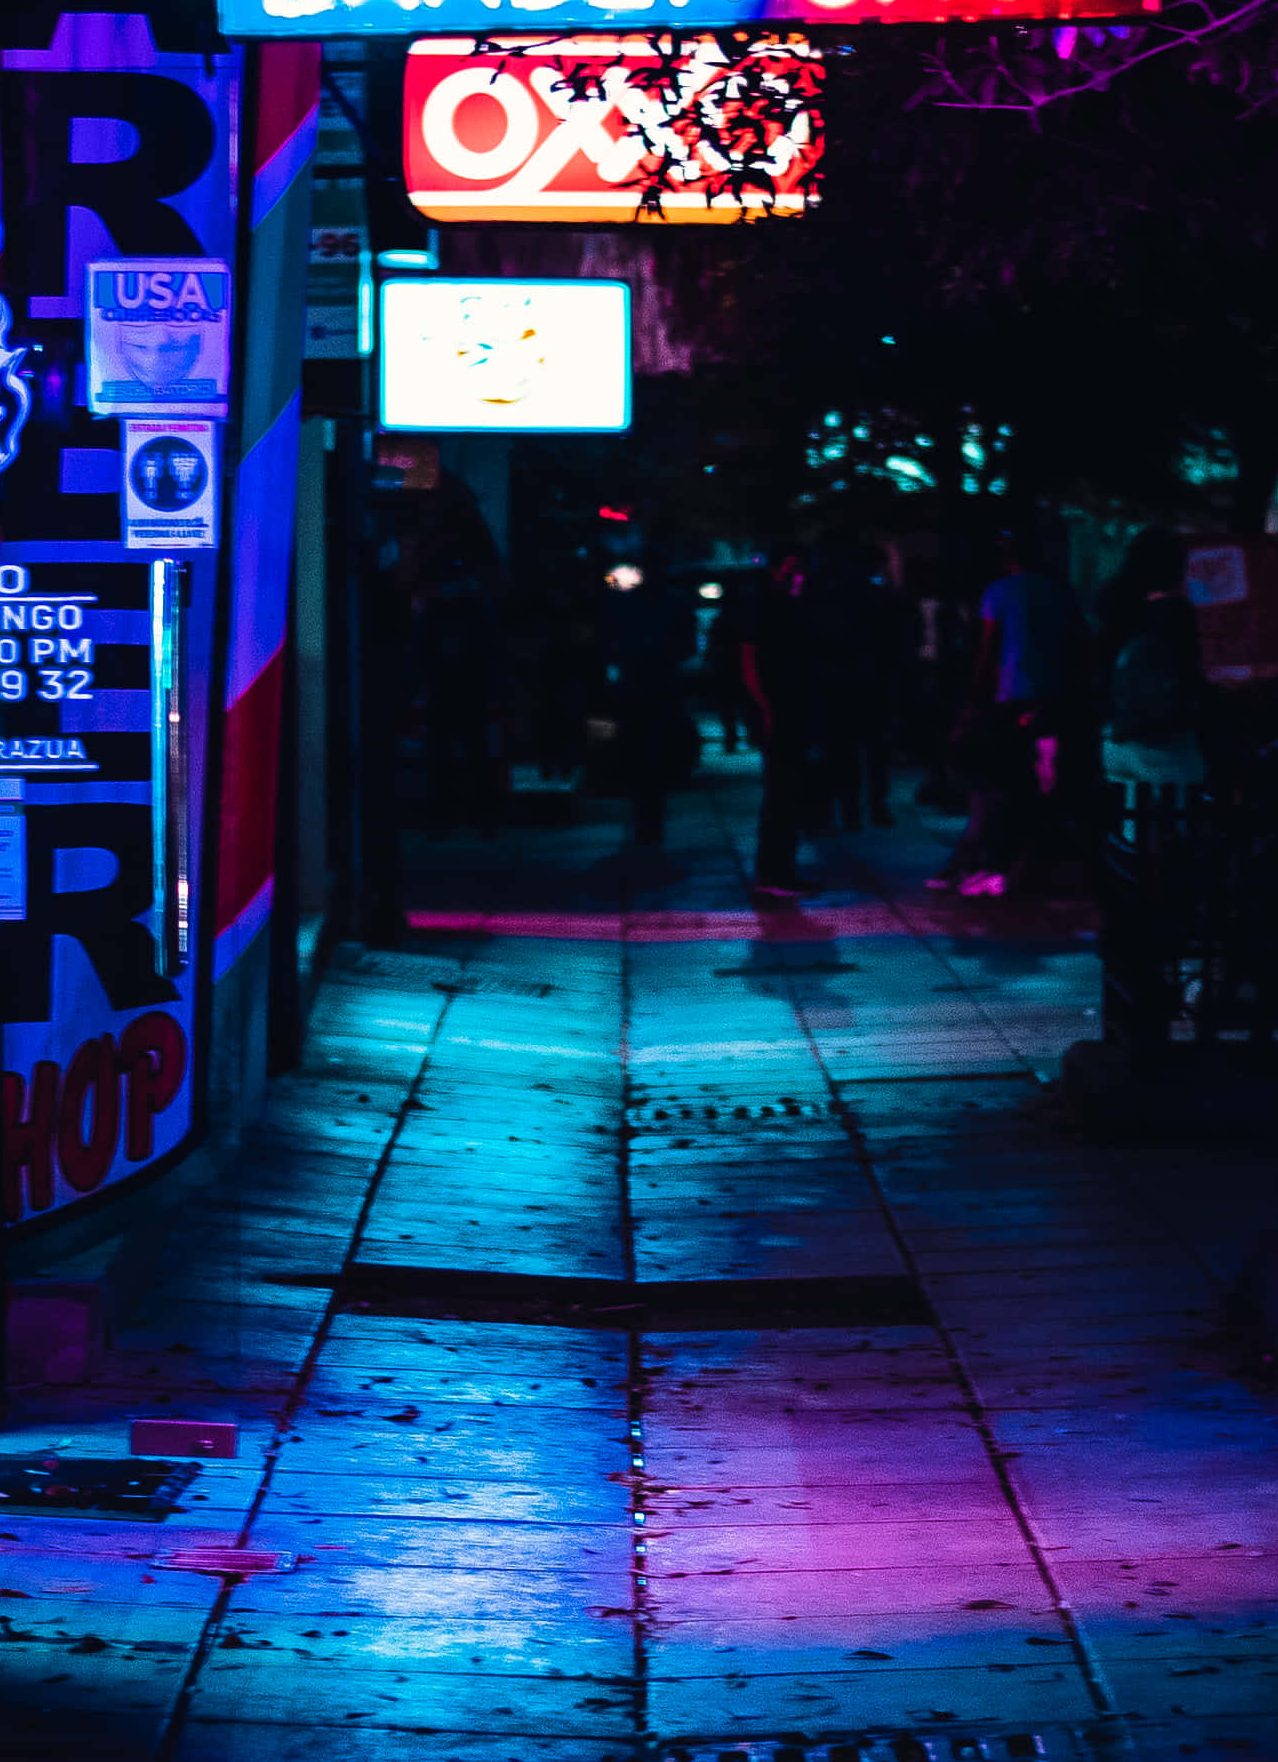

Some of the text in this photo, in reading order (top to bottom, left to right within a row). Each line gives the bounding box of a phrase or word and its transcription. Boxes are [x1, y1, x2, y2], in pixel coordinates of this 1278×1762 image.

[117, 272, 209, 309] USA
[30, 637, 94, 665] PM
[38, 668, 96, 700] 32
